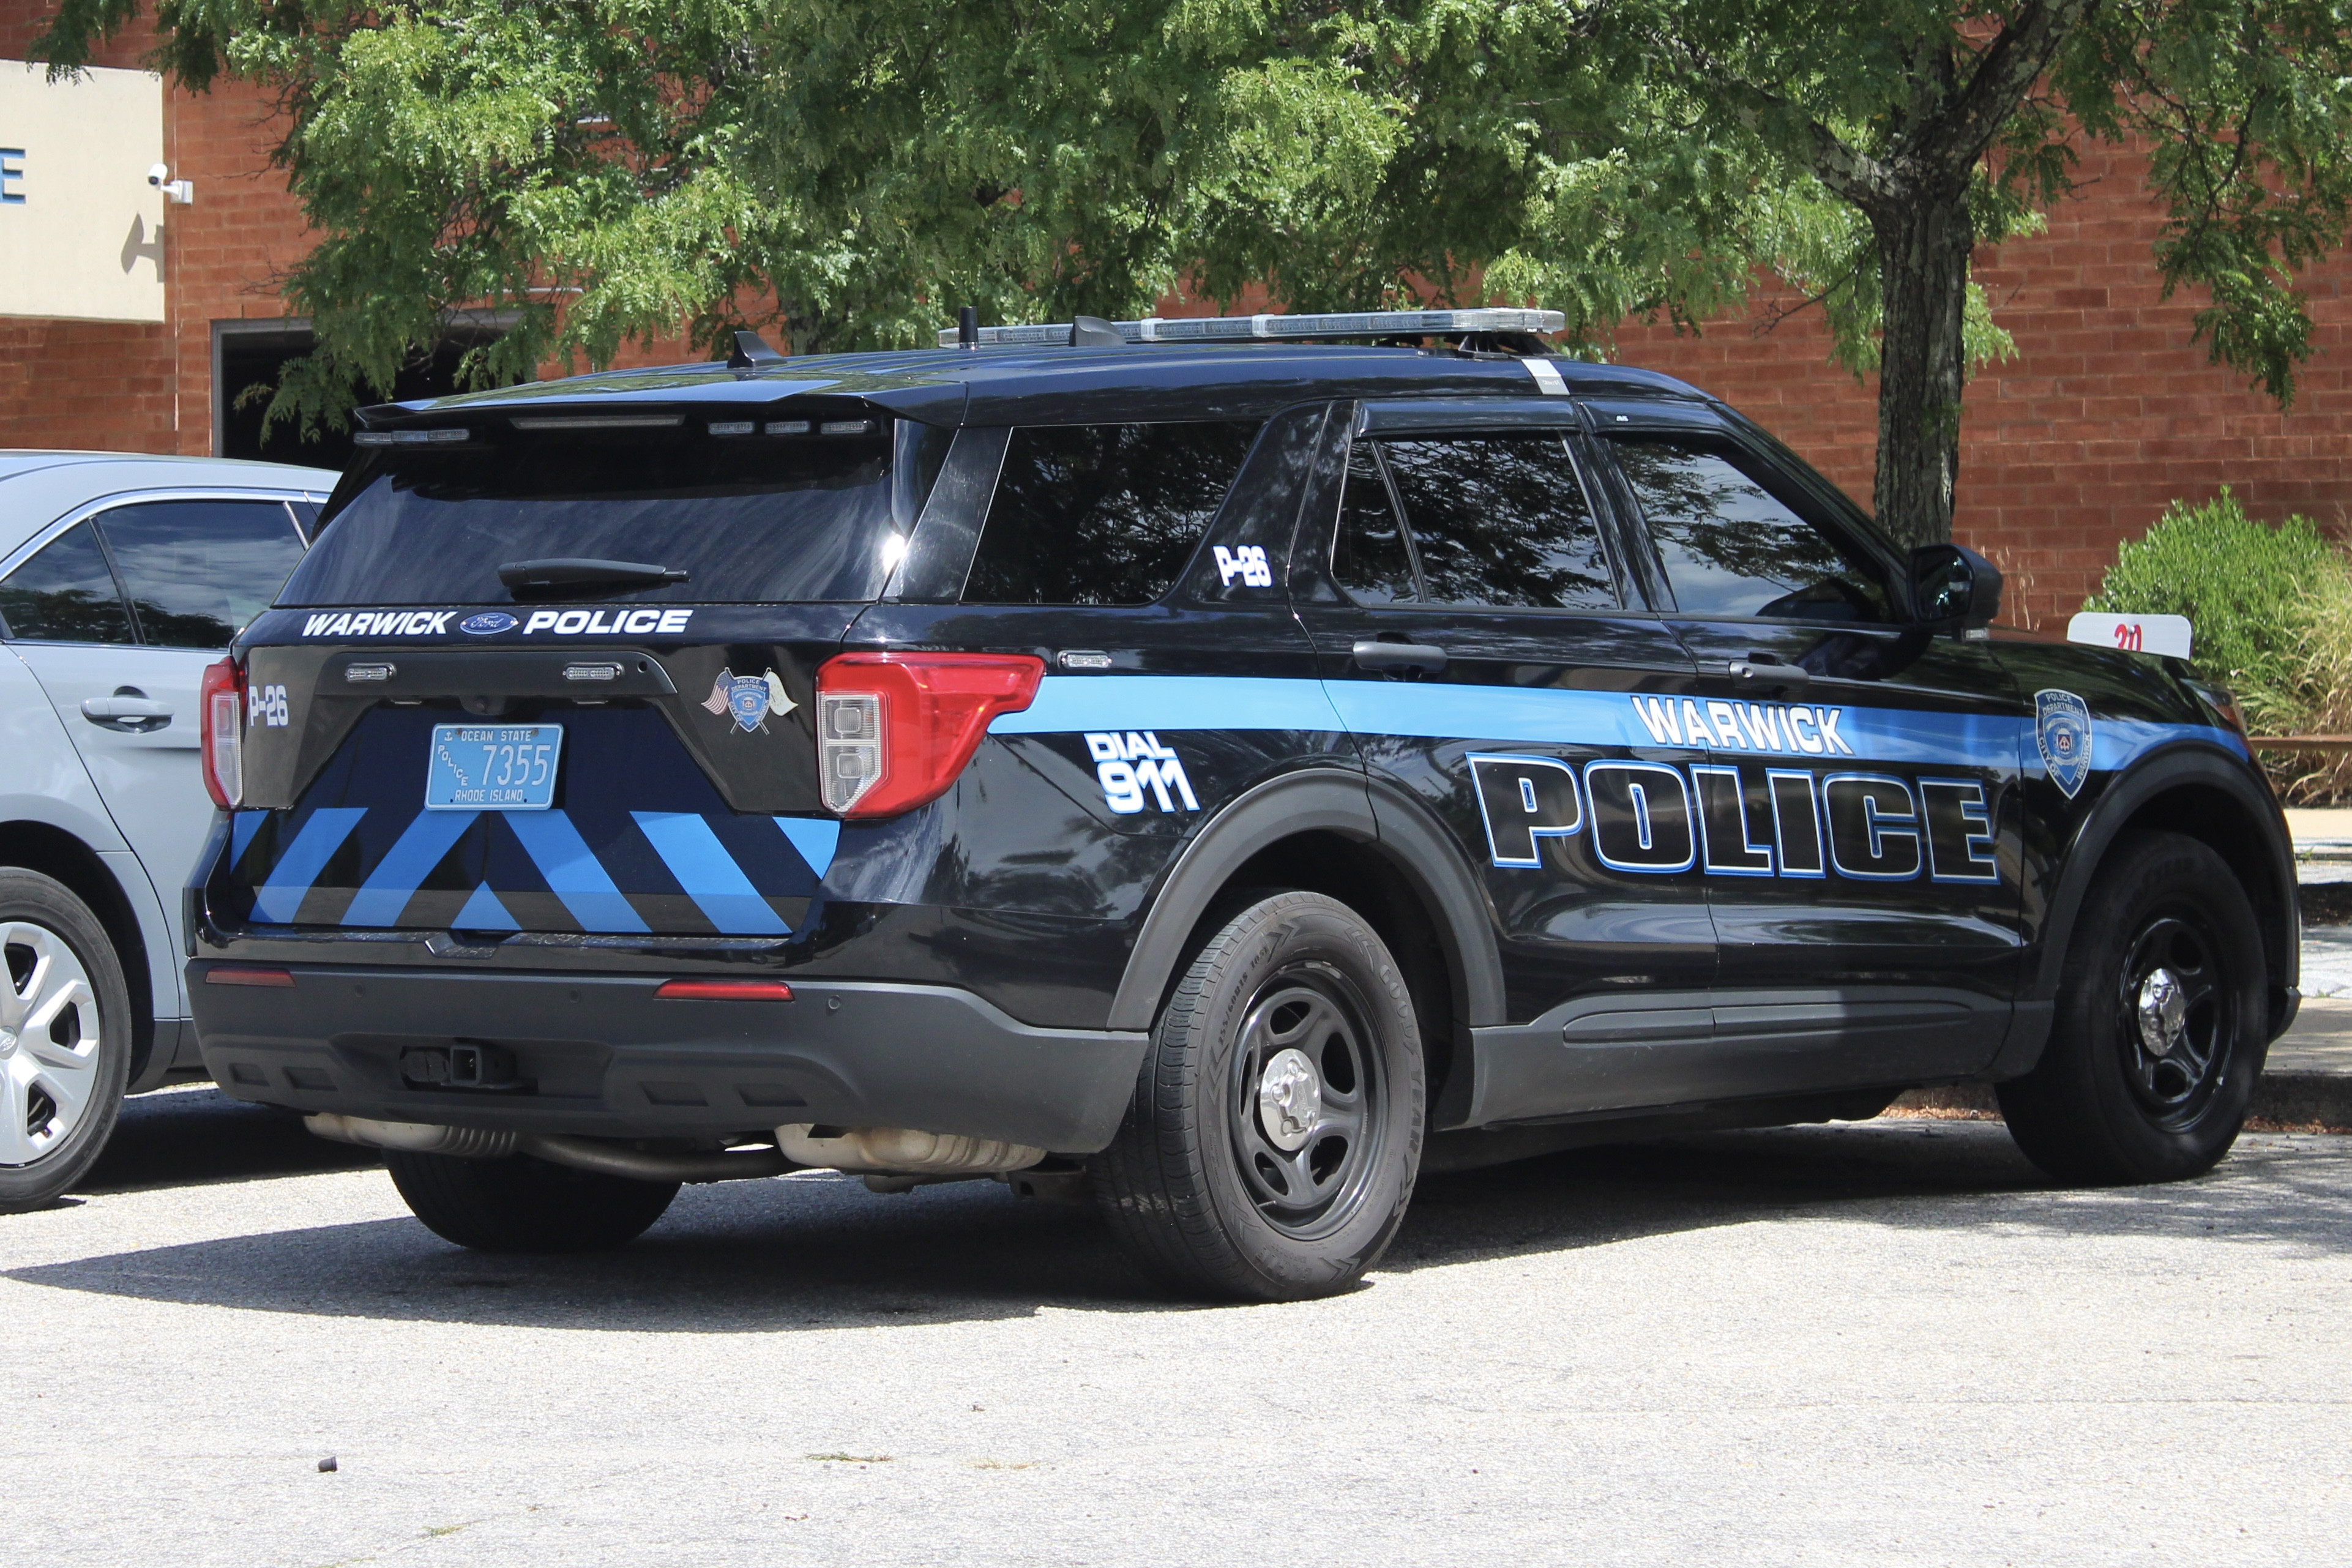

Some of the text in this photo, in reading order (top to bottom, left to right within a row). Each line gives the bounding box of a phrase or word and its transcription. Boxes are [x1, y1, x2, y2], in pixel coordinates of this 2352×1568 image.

[1212, 544, 1272, 588] P-26
[302, 611, 459, 637] WARWICK
[469, 613, 505, 629] Ford
[522, 609, 694, 635] POLICE
[248, 685, 289, 726] P-26
[2042, 702, 2083, 717] DEPARTMENT
[2045, 693, 2073, 704] POLICE
[461, 730, 532, 742] OCEAN STATE
[1630, 695, 1857, 756] WARWICK
[437, 744, 469, 786] POLICE
[482, 744, 551, 786] 7355
[1083, 731, 1178, 763] DIAL
[2039, 736, 2061, 777] CITY OF
[2075, 733, 2090, 780] WARWICK
[455, 789, 523, 802] RHODE ISLAND
[1097, 759, 1201, 815] 911
[1465, 752, 2001, 886] POLICE
